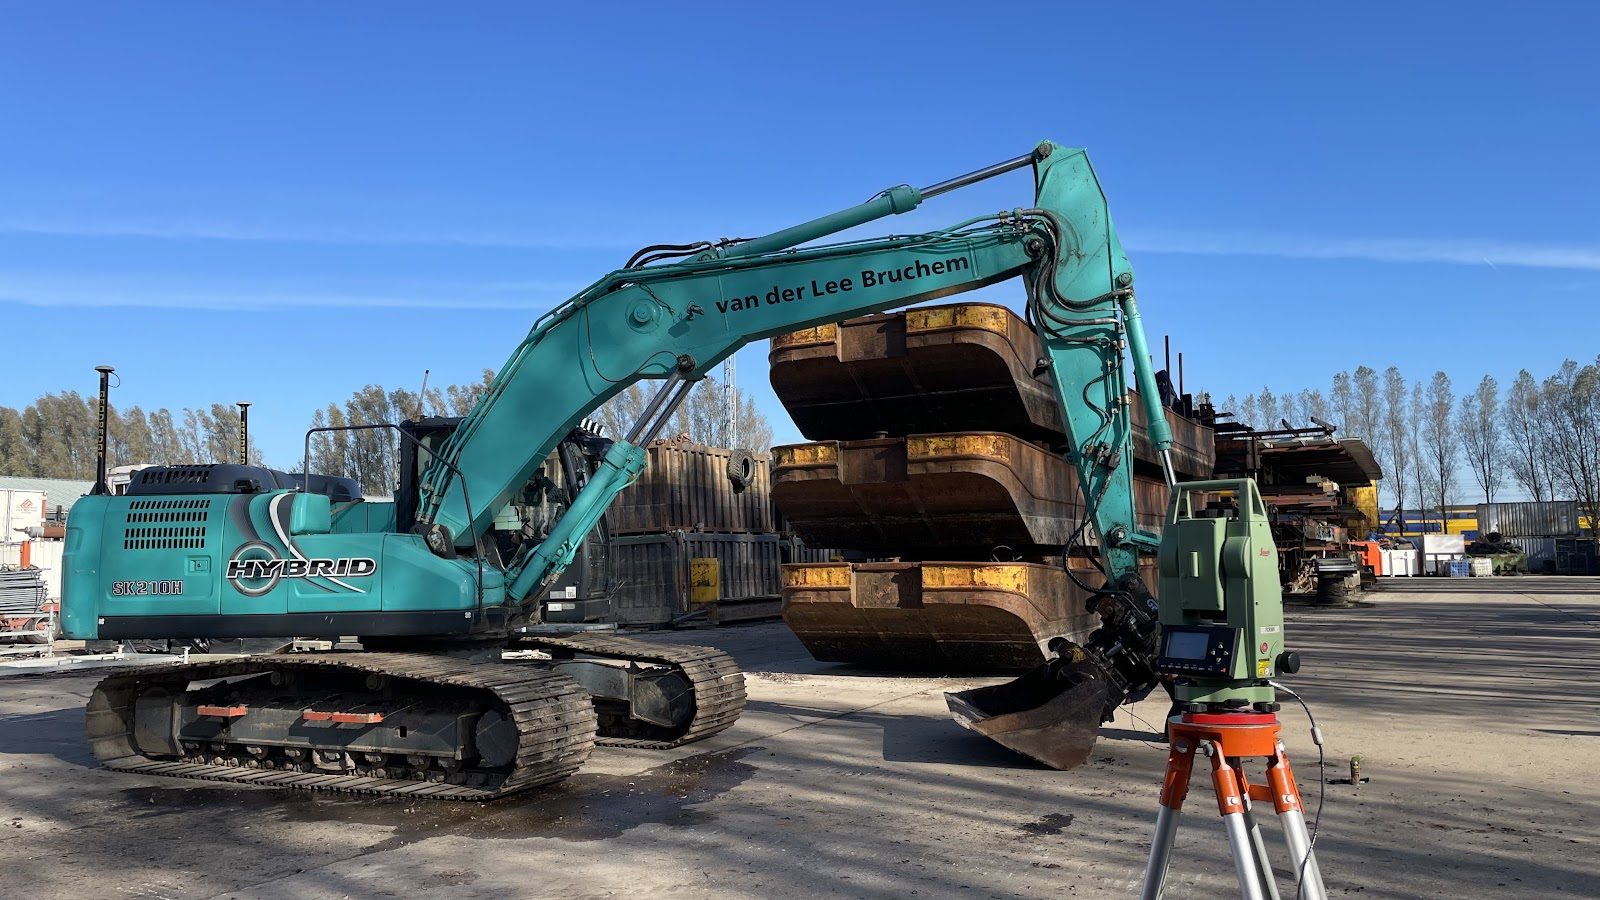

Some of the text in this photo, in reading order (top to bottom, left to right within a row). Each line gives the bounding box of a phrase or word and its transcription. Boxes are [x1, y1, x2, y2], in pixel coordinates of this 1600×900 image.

[716, 256, 969, 314] van der Lee Bruchem
[225, 557, 377, 579] HYBRID
[112, 580, 184, 596] SK210H
